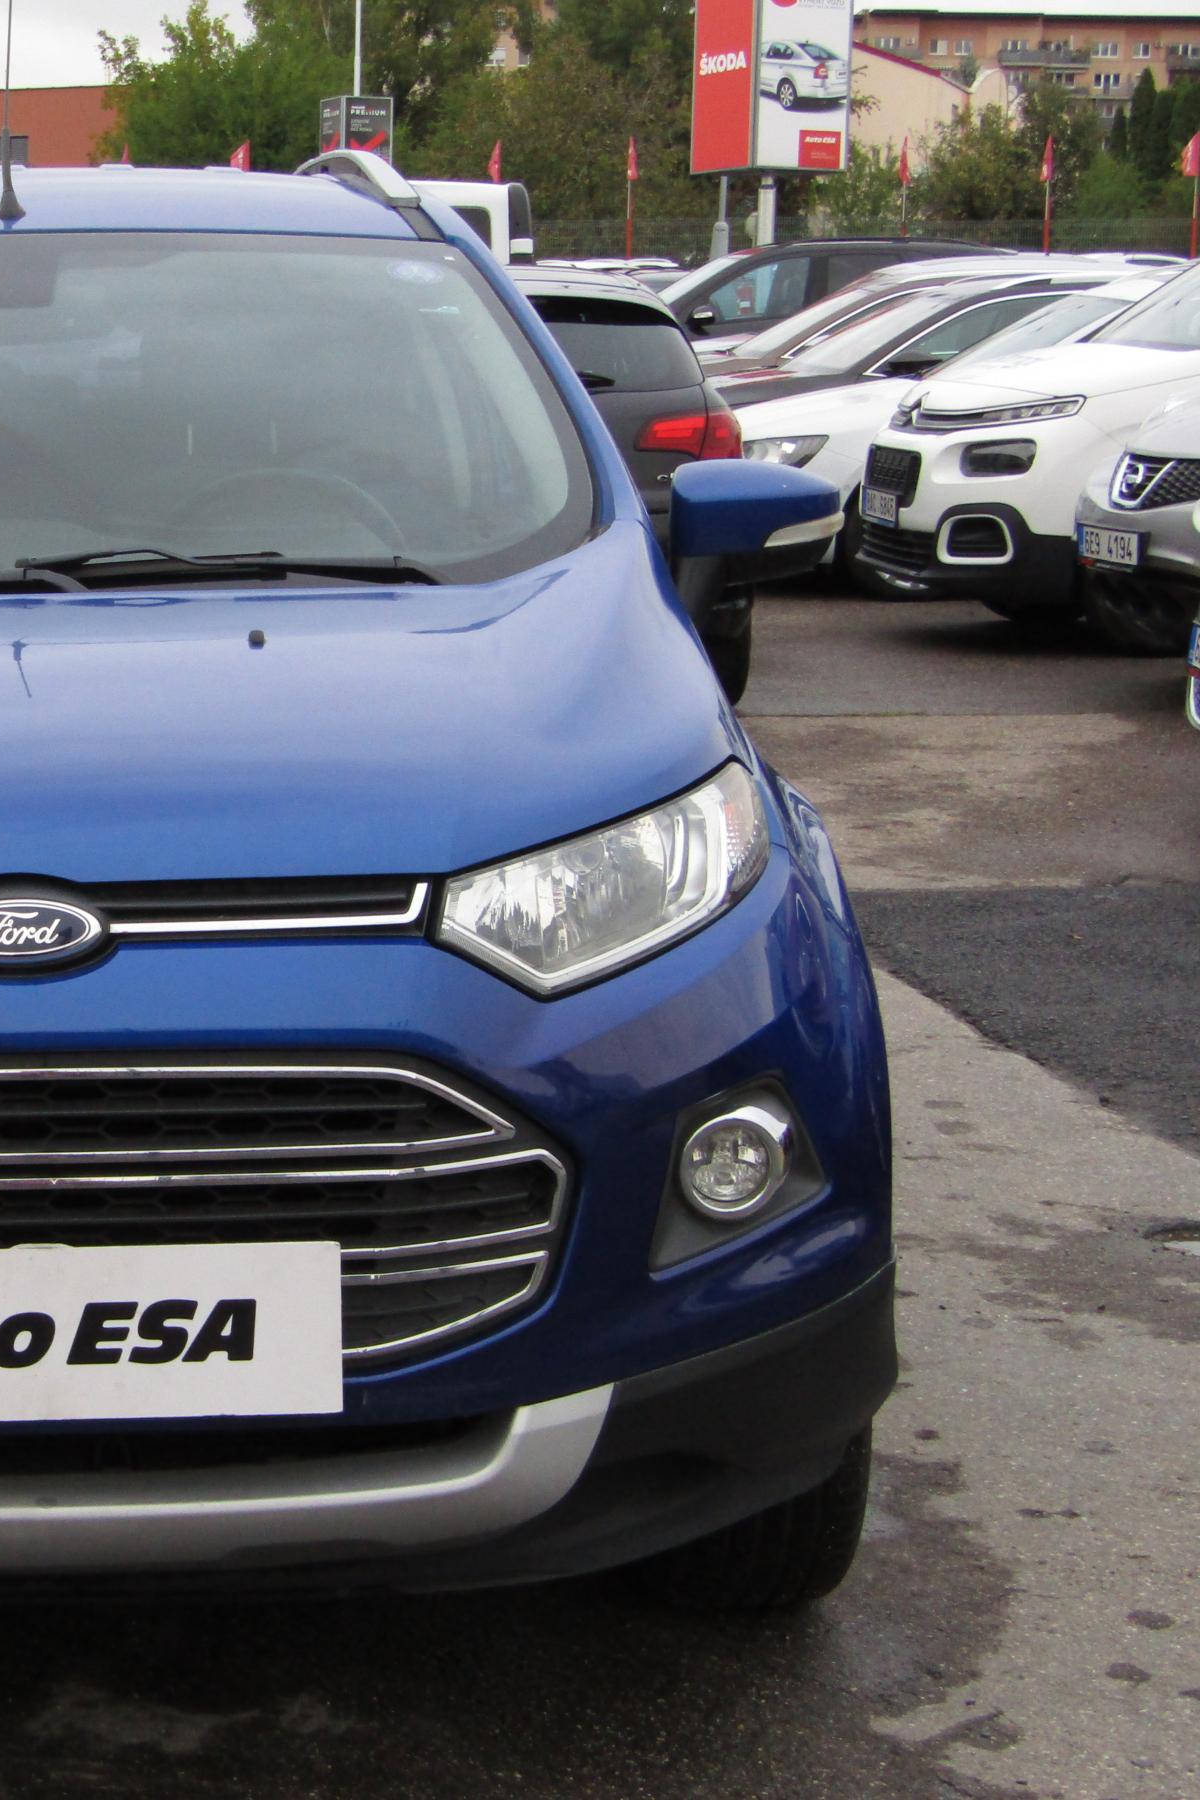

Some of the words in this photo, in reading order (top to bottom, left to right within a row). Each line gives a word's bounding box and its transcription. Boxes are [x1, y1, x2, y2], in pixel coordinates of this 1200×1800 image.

[699, 51, 747, 76] ŠKODA
[1107, 534, 1132, 560] 4194
[66, 1299, 257, 1365] ESA
